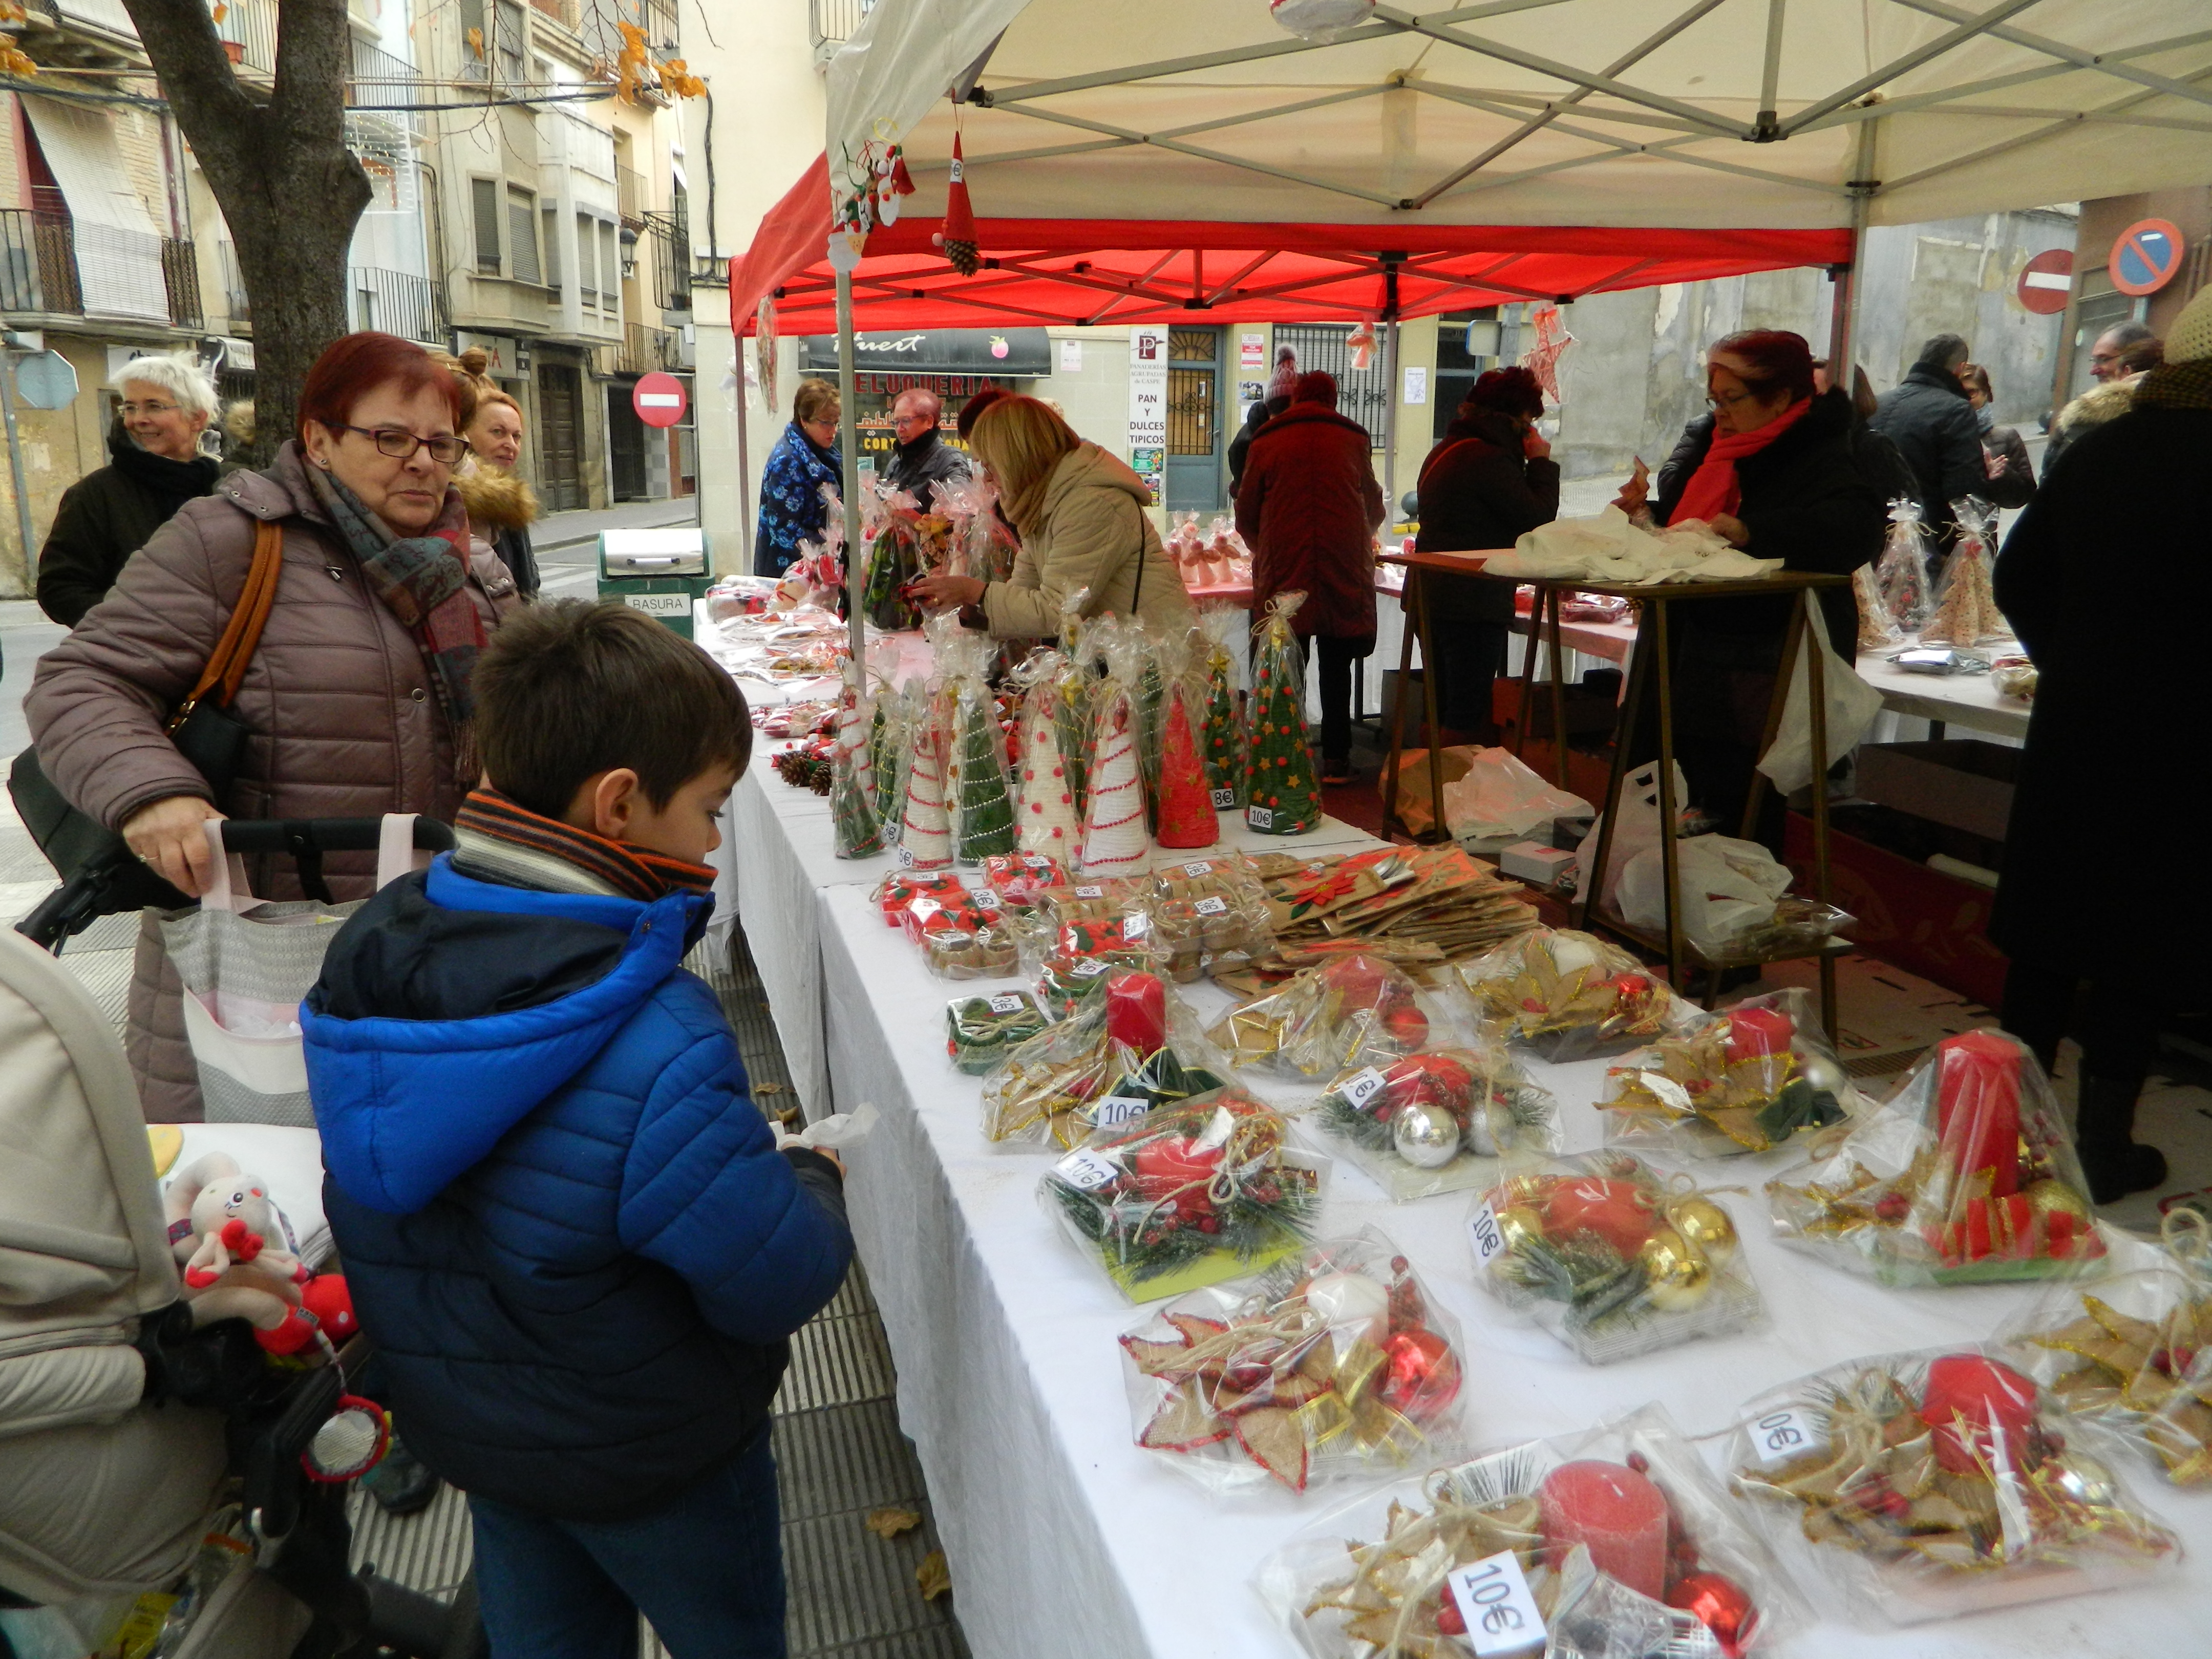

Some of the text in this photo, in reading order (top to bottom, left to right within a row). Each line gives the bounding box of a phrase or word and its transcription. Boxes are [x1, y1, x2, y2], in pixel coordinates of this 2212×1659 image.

[854, 373, 992, 396] ELUQUERIA
[1138, 394, 1157, 403] PAN
[1144, 408, 1151, 416] Y
[1130, 421, 1164, 430] DULCES
[1129, 435, 1164, 443] TIPICOS
[632, 598, 683, 609] BASURA
[1215, 790, 1232, 805] 8€
[1252, 810, 1271, 825] 10€
[883, 823, 896, 840] 3€
[899, 848, 912, 866] 5€
[1025, 857, 1044, 865] 3€
[1186, 863, 1206, 875] 3€
[1077, 886, 1096, 896] 3€
[973, 891, 994, 905] 3€
[1197, 899, 1219, 911] 3€
[991, 997, 1015, 1010] 3€
[1066, 1158, 1107, 1184] 10€
[1473, 1209, 1499, 1257] 10€
[1757, 1411, 1803, 1450] 0€
[1463, 1563, 1525, 1635] 10€
